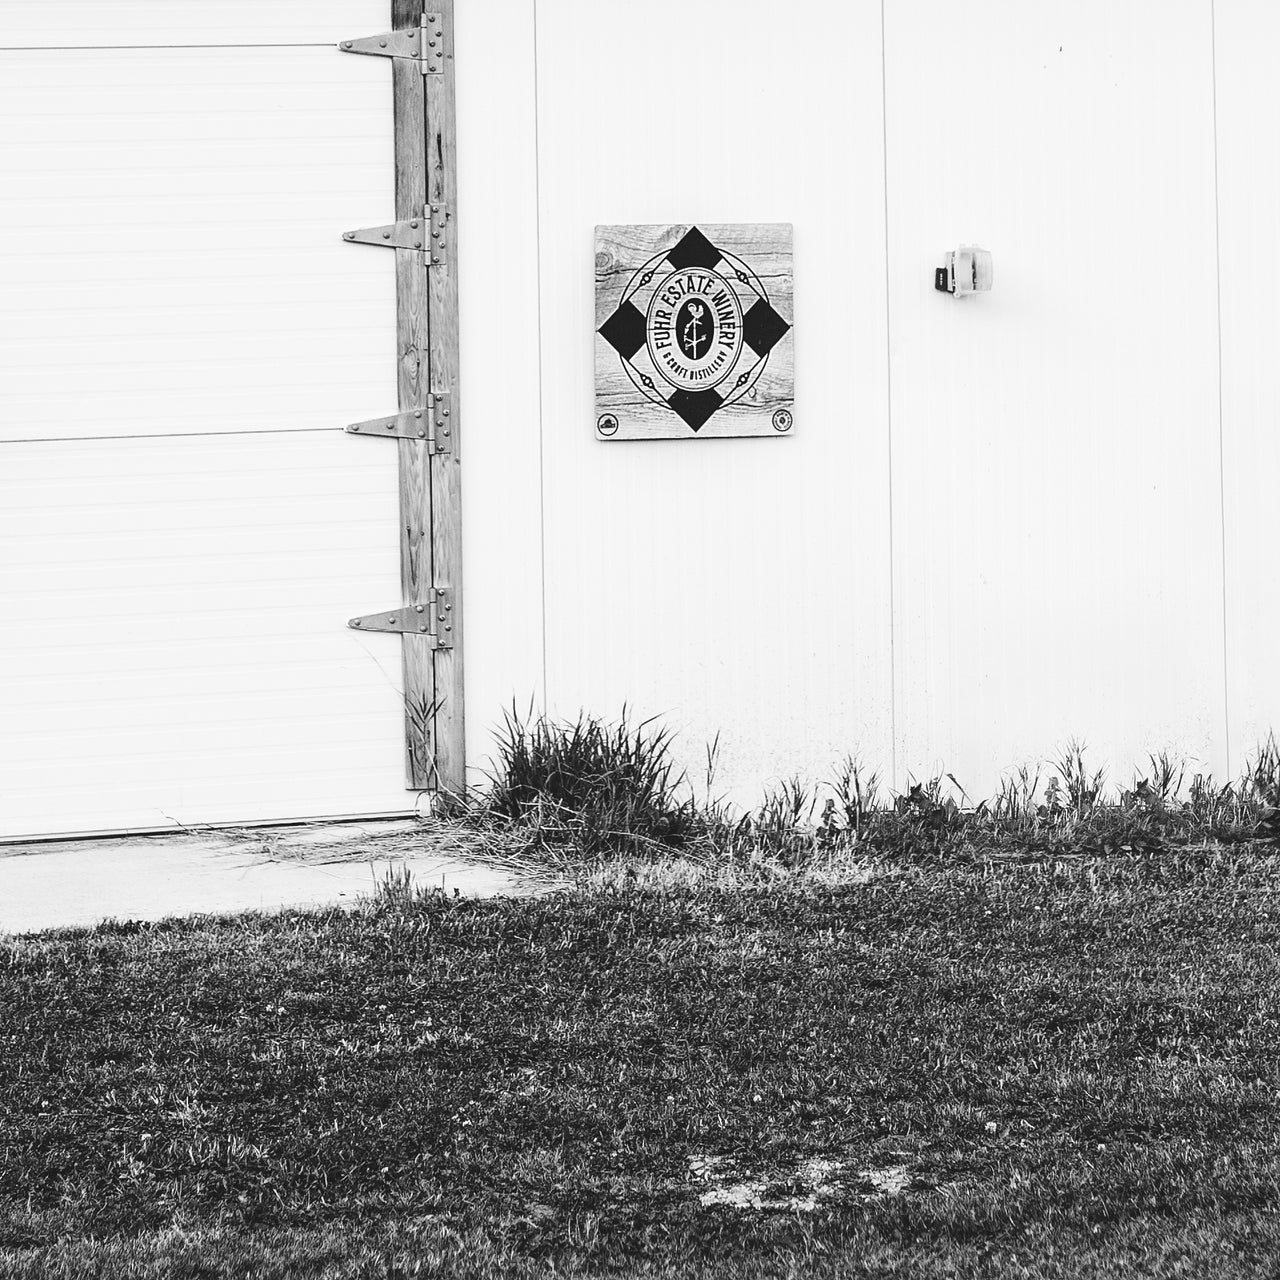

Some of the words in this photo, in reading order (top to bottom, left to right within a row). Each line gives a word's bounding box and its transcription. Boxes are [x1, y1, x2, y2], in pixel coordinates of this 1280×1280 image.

[661, 275, 715, 308] ESTATE
[654, 309, 672, 350] FUHR
[711, 288, 736, 350] WINERY
